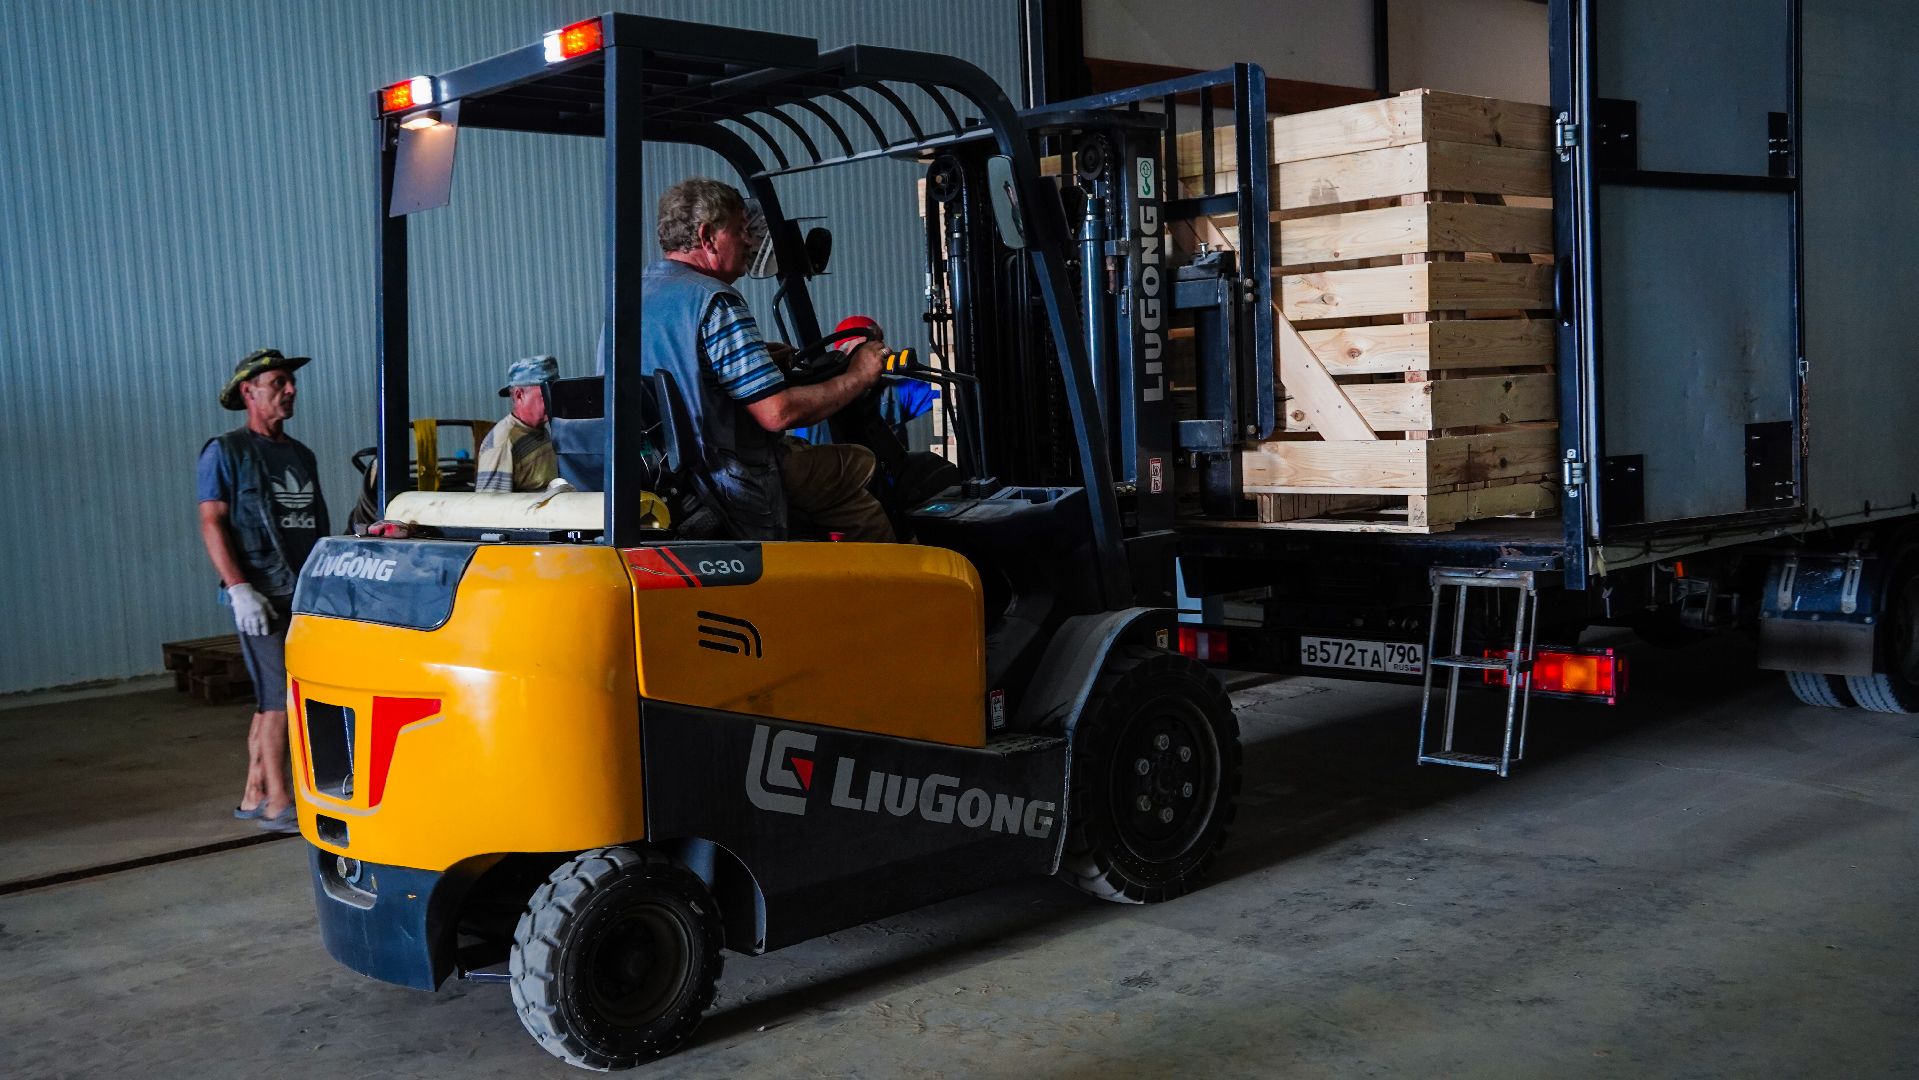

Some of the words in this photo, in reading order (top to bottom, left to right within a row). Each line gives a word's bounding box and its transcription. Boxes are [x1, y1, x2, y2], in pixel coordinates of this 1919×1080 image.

[1140, 205, 1164, 401] LIUGONG
[698, 559, 745, 576] C30
[1307, 640, 1382, 669] В572ТА
[1386, 644, 1418, 664] 790
[831, 756, 1055, 838] LIUGONG
